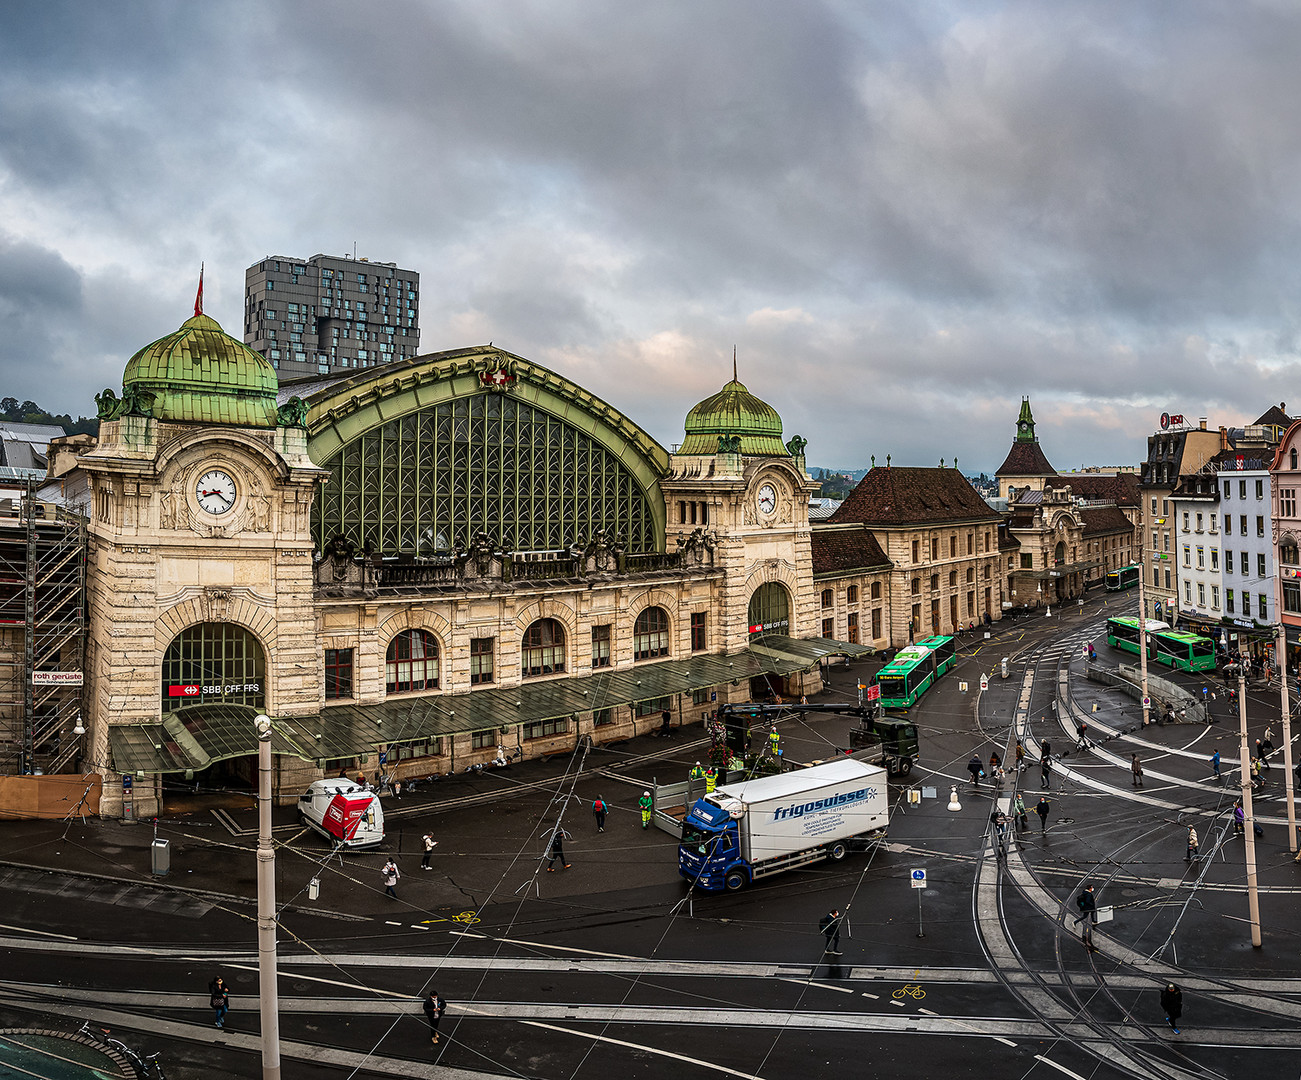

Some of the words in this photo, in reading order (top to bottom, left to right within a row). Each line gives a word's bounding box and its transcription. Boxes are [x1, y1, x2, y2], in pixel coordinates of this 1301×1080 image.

[202, 686, 222, 694] SBB
[224, 685, 241, 694] CFF
[243, 684, 260, 692] FFS
[773, 788, 865, 820] frigosuisse
